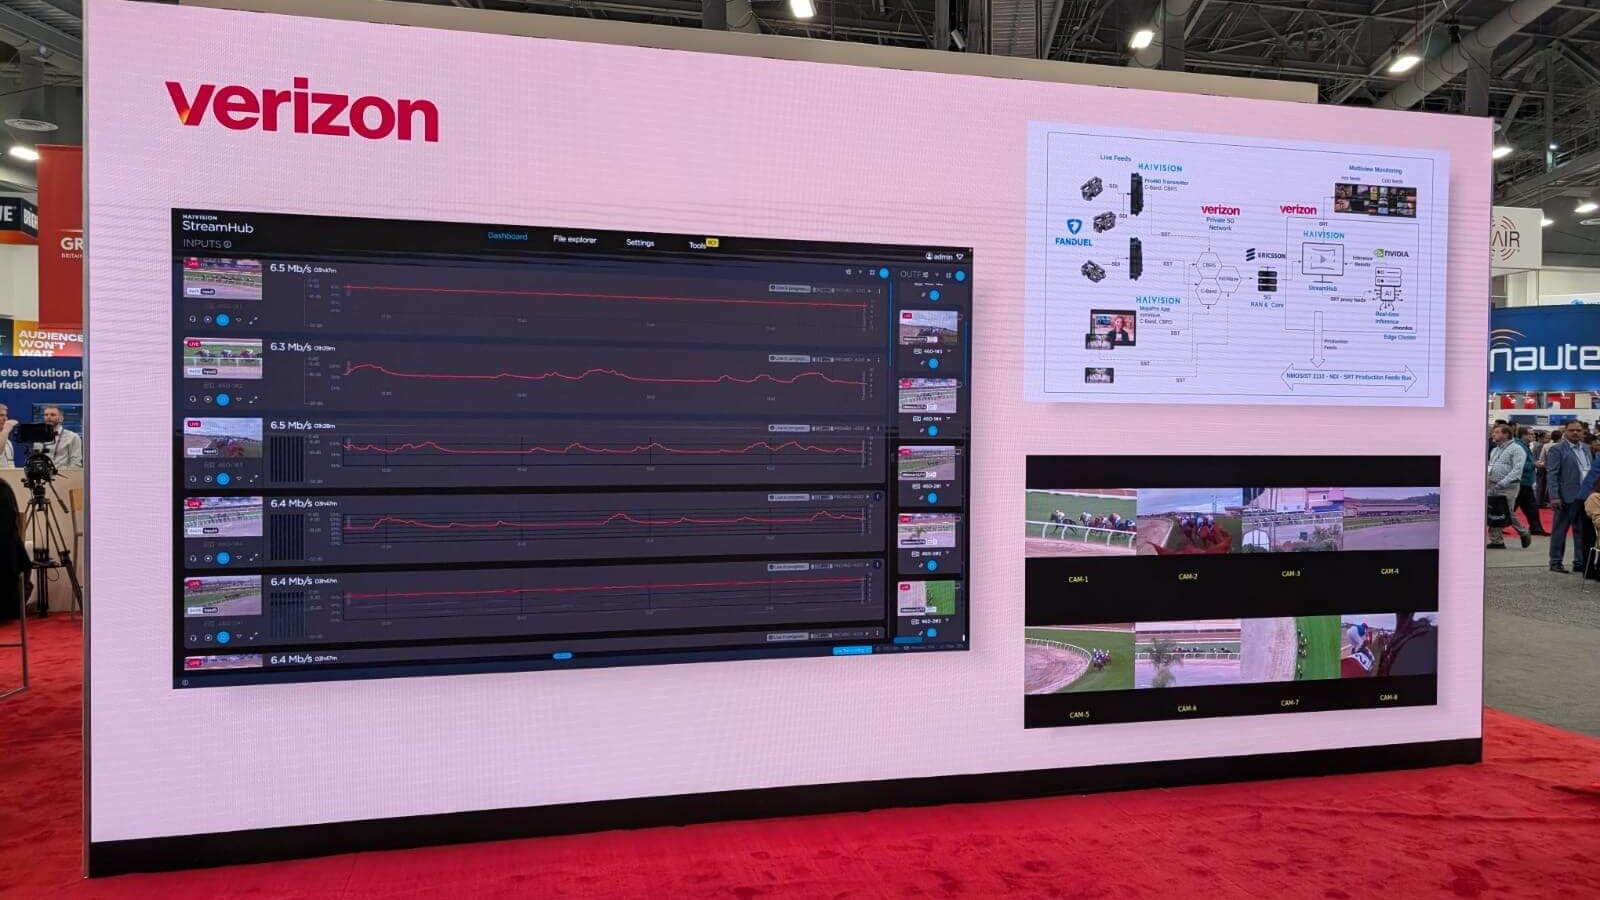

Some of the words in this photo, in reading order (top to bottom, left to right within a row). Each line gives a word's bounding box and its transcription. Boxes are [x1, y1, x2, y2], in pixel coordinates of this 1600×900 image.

[165, 77, 439, 142] verizon
[1138, 163, 1183, 172] HAIVISION
[1201, 204, 1240, 216] verizon
[1280, 204, 1317, 215] verizon
[182, 220, 254, 233] StreamHub
[487, 231, 528, 241] Dashboard
[553, 235, 567, 243] File
[568, 236, 597, 245] explorer
[1303, 231, 1344, 239] HAIVISION
[183, 238, 222, 248] INPUTS
[626, 238, 655, 248] Settings
[689, 241, 706, 249] Tools
[1055, 238, 1093, 247] FANDUEL
[270, 263, 285, 272] 6.5
[287, 263, 312, 274] Mb/s
[1135, 296, 1181, 304] HAIVISION
[19, 330, 83, 343] AUDIENCE
[19, 340, 65, 350] WON'T
[270, 342, 285, 351] 6.3
[287, 342, 312, 352] Mb/s
[22, 368, 70, 377] solution
[270, 421, 286, 430] 6.5
[287, 420, 312, 430] Mb/s
[270, 500, 286, 508] 6.4
[289, 498, 313, 509] Mb/s
[1380, 567, 1399, 575] CAM-4
[270, 577, 286, 586] 6.4
[289, 576, 313, 587] Mb/s
[1068, 575, 1089, 583] CAM-1
[1178, 572, 1198, 581] CAM-2
[270, 655, 286, 664] 6.4
[289, 654, 313, 665] Mb/s
[1281, 699, 1300, 707] CAM-7
